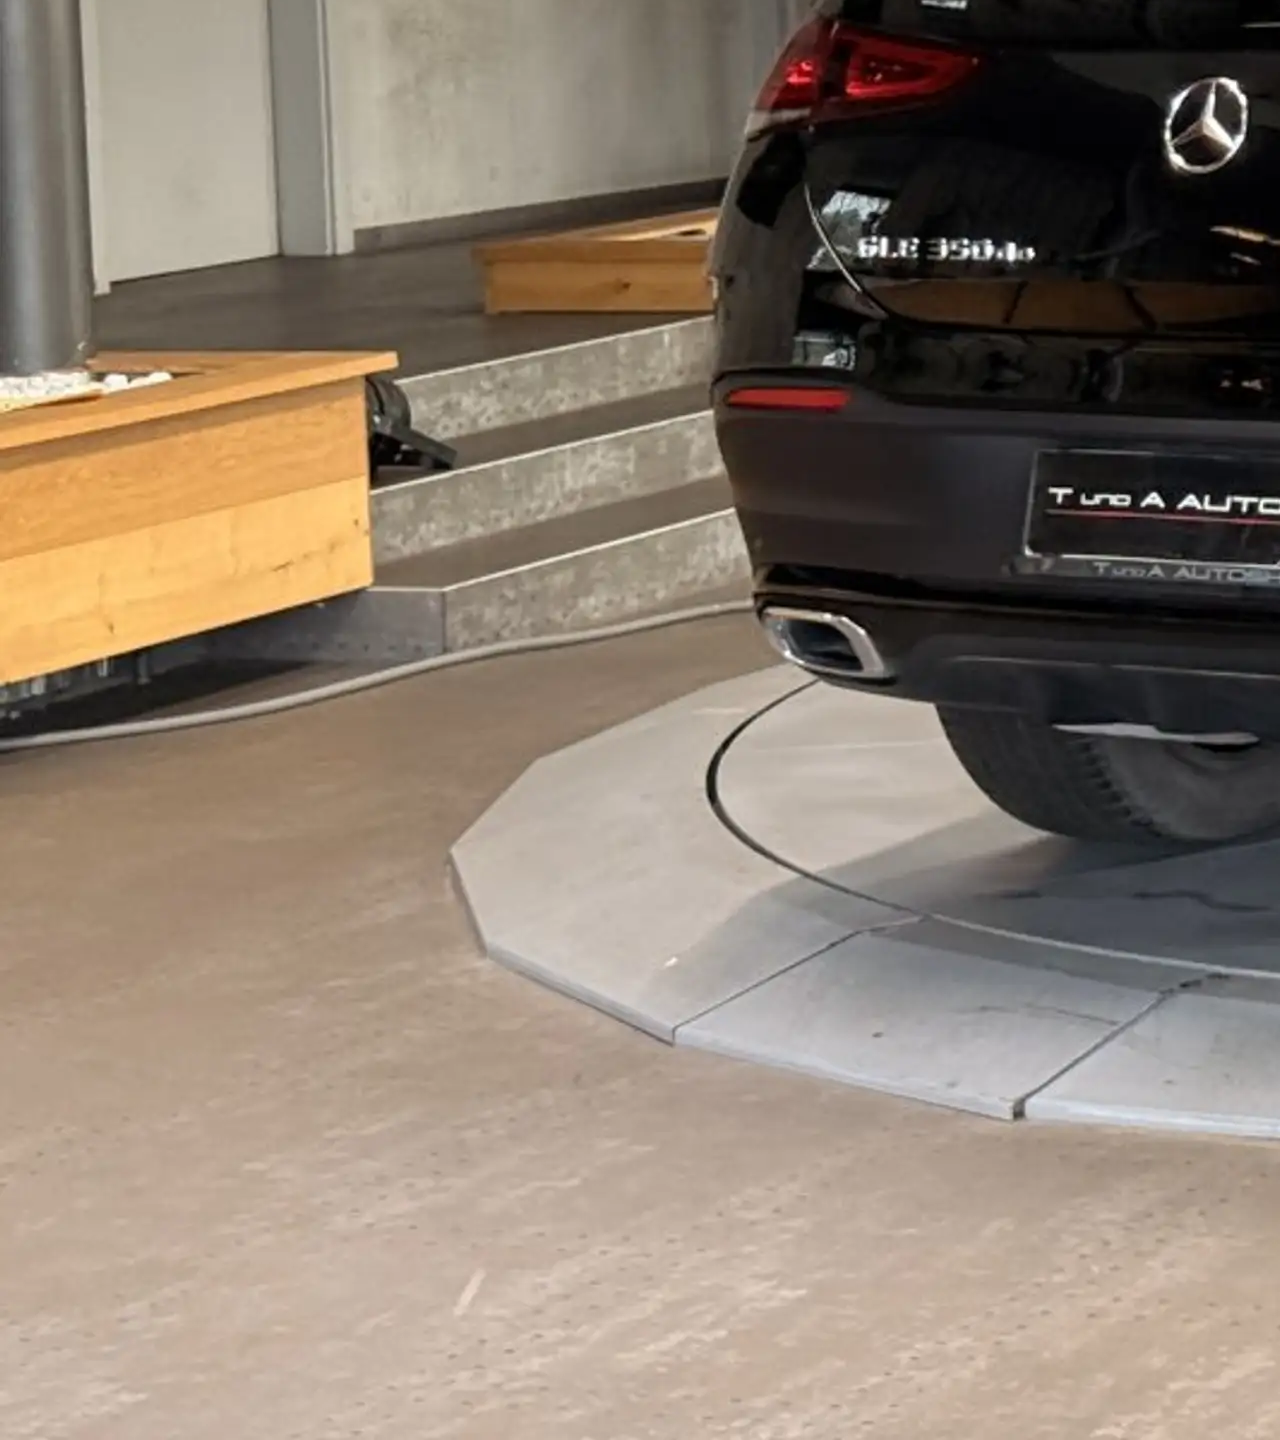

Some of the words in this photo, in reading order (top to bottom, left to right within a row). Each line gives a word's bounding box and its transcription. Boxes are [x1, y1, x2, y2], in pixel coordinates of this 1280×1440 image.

[857, 235, 921, 259] GLE
[1048, 487, 1074, 505] T
[1140, 491, 1166, 509] A
